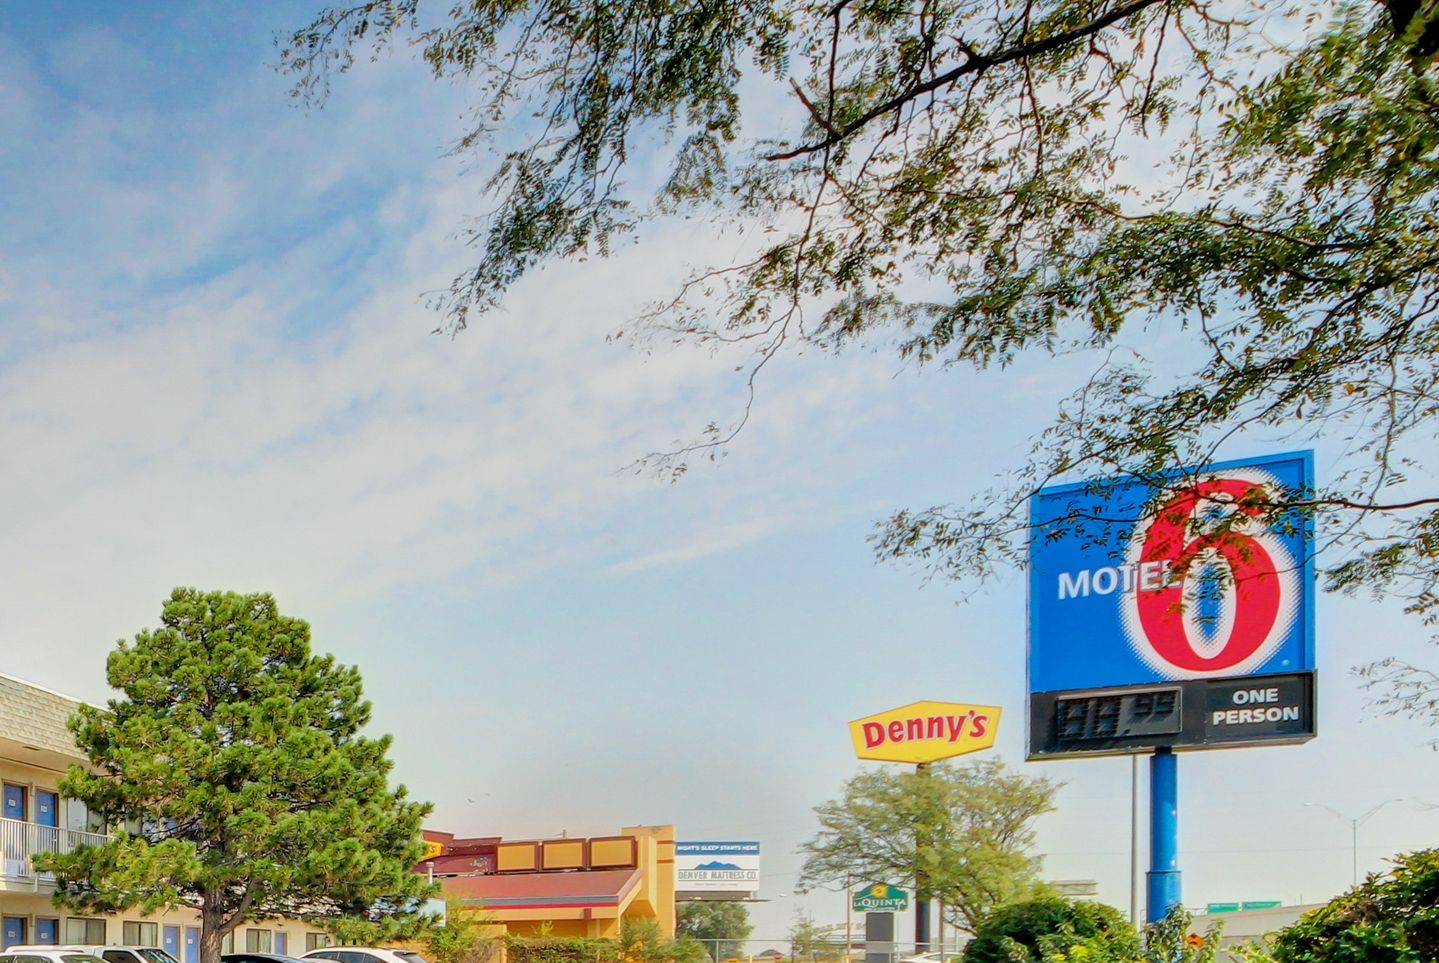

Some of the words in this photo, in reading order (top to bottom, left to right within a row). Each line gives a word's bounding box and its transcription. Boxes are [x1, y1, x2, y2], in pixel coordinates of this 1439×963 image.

[1058, 558, 1184, 600] MOTEL
[1232, 687, 1279, 705] ONE
[1212, 706, 1299, 725] PERSON
[862, 710, 988, 748] Denny's
[678, 871, 708, 880] DENVER
[710, 871, 744, 880] MATTRESS
[861, 898, 907, 908] QUINTA
